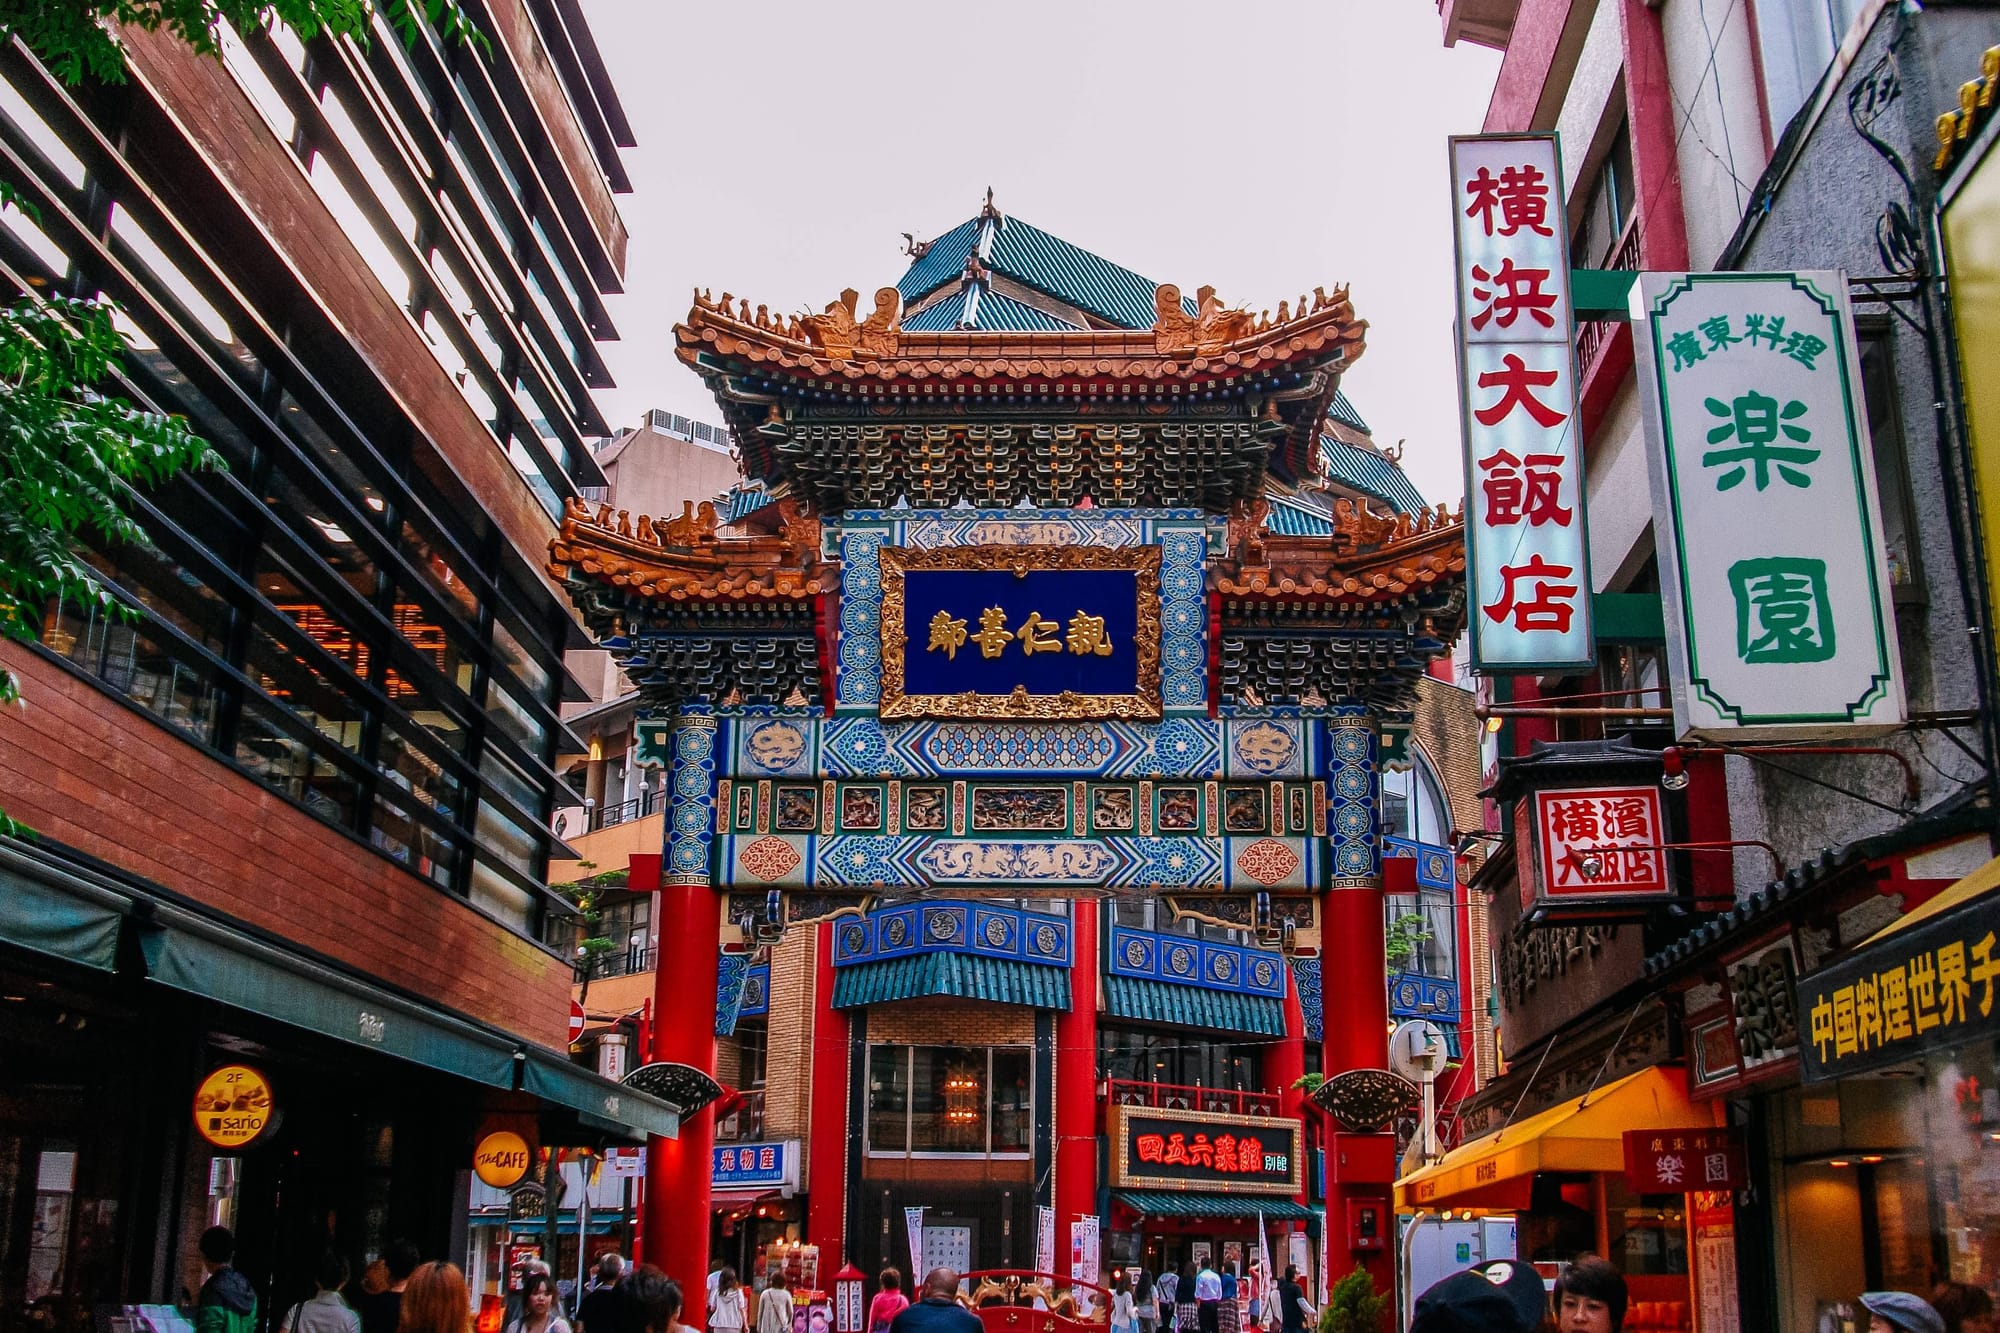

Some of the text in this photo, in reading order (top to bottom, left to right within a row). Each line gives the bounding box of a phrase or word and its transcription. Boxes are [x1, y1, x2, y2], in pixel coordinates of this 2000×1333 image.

[1665, 313, 1828, 373] 廣東料理
[1465, 164, 1579, 634] 横浜大飯店
[1702, 390, 1836, 664] 楽園
[226, 1073, 243, 1083] 2F
[223, 1114, 262, 1129] sario
[477, 1151, 526, 1169] The CAFE
[712, 1147, 775, 1171] 光物産
[1136, 1133, 1288, 1173] 四五六菜館 別館
